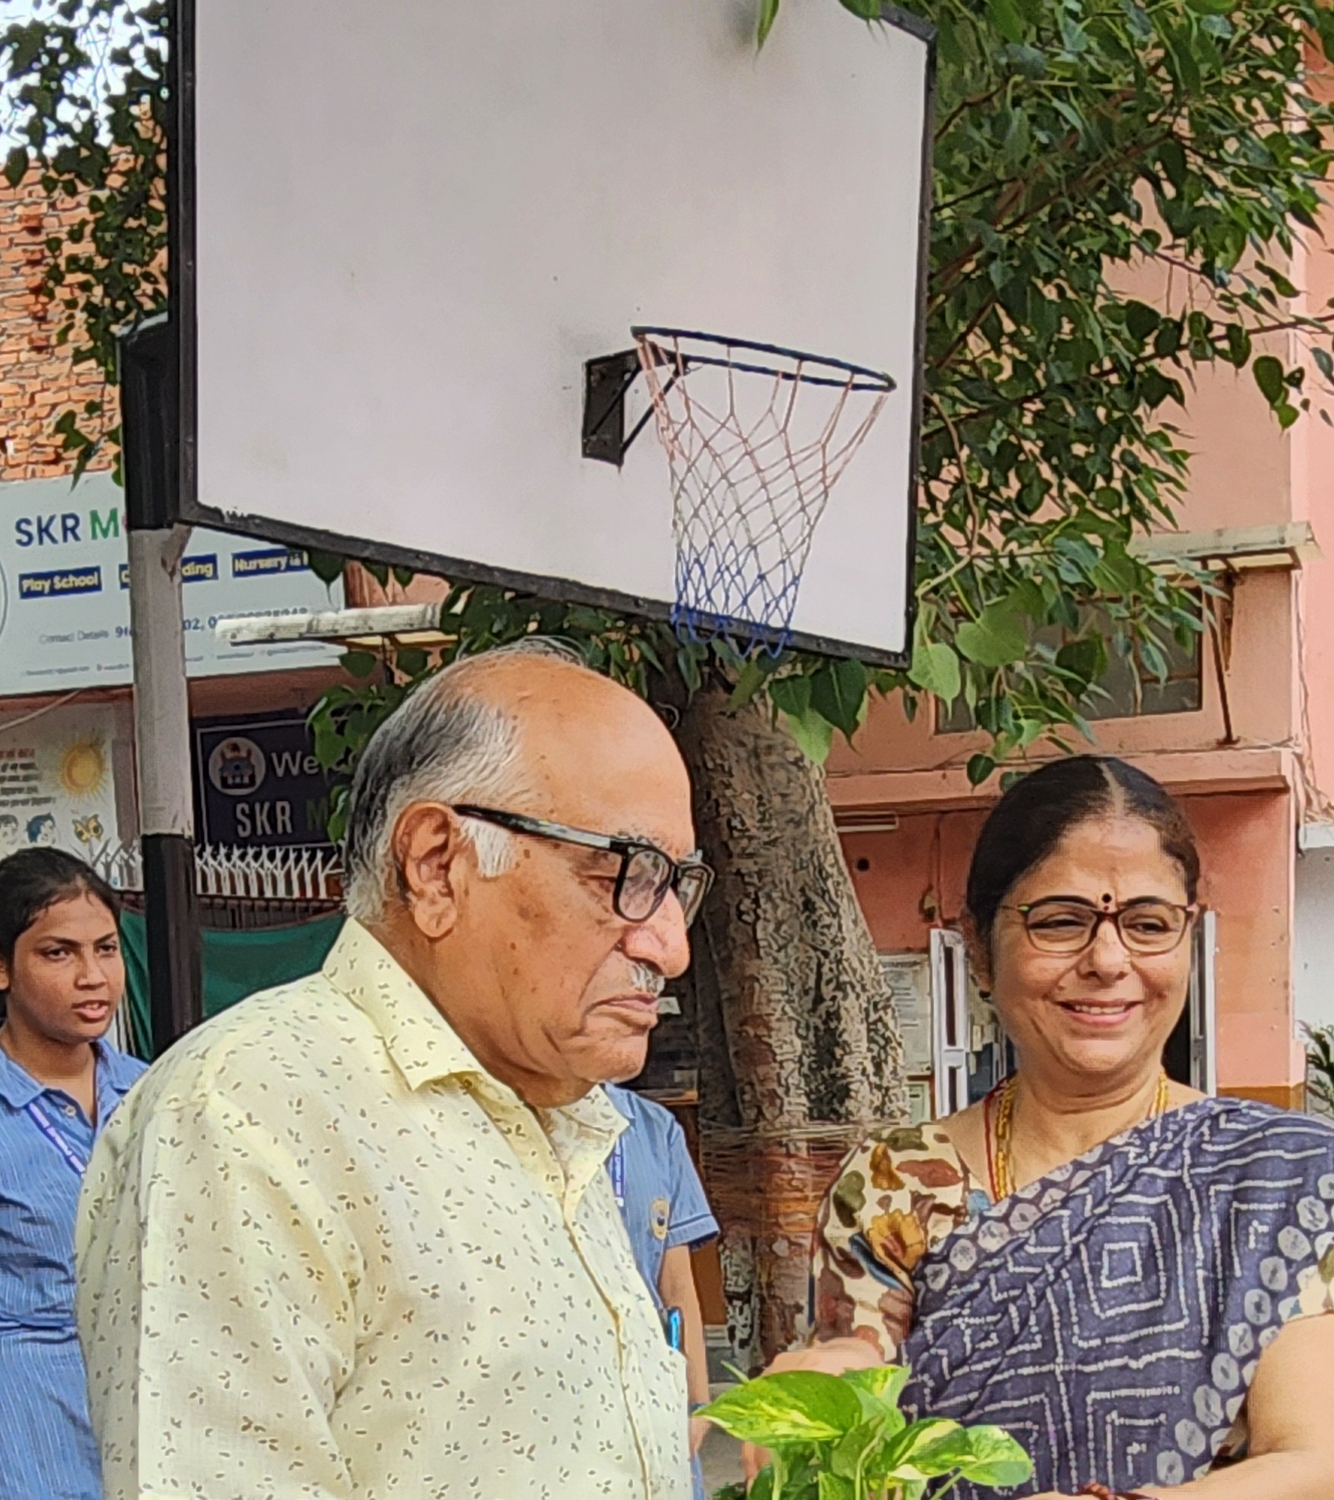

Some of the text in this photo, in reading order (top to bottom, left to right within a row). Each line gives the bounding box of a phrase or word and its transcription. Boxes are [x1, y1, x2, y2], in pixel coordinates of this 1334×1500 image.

[14, 507, 123, 547] SKR M
[22, 571, 98, 595] Play School
[270, 750, 319, 778] We
[235, 800, 293, 838] SKR
